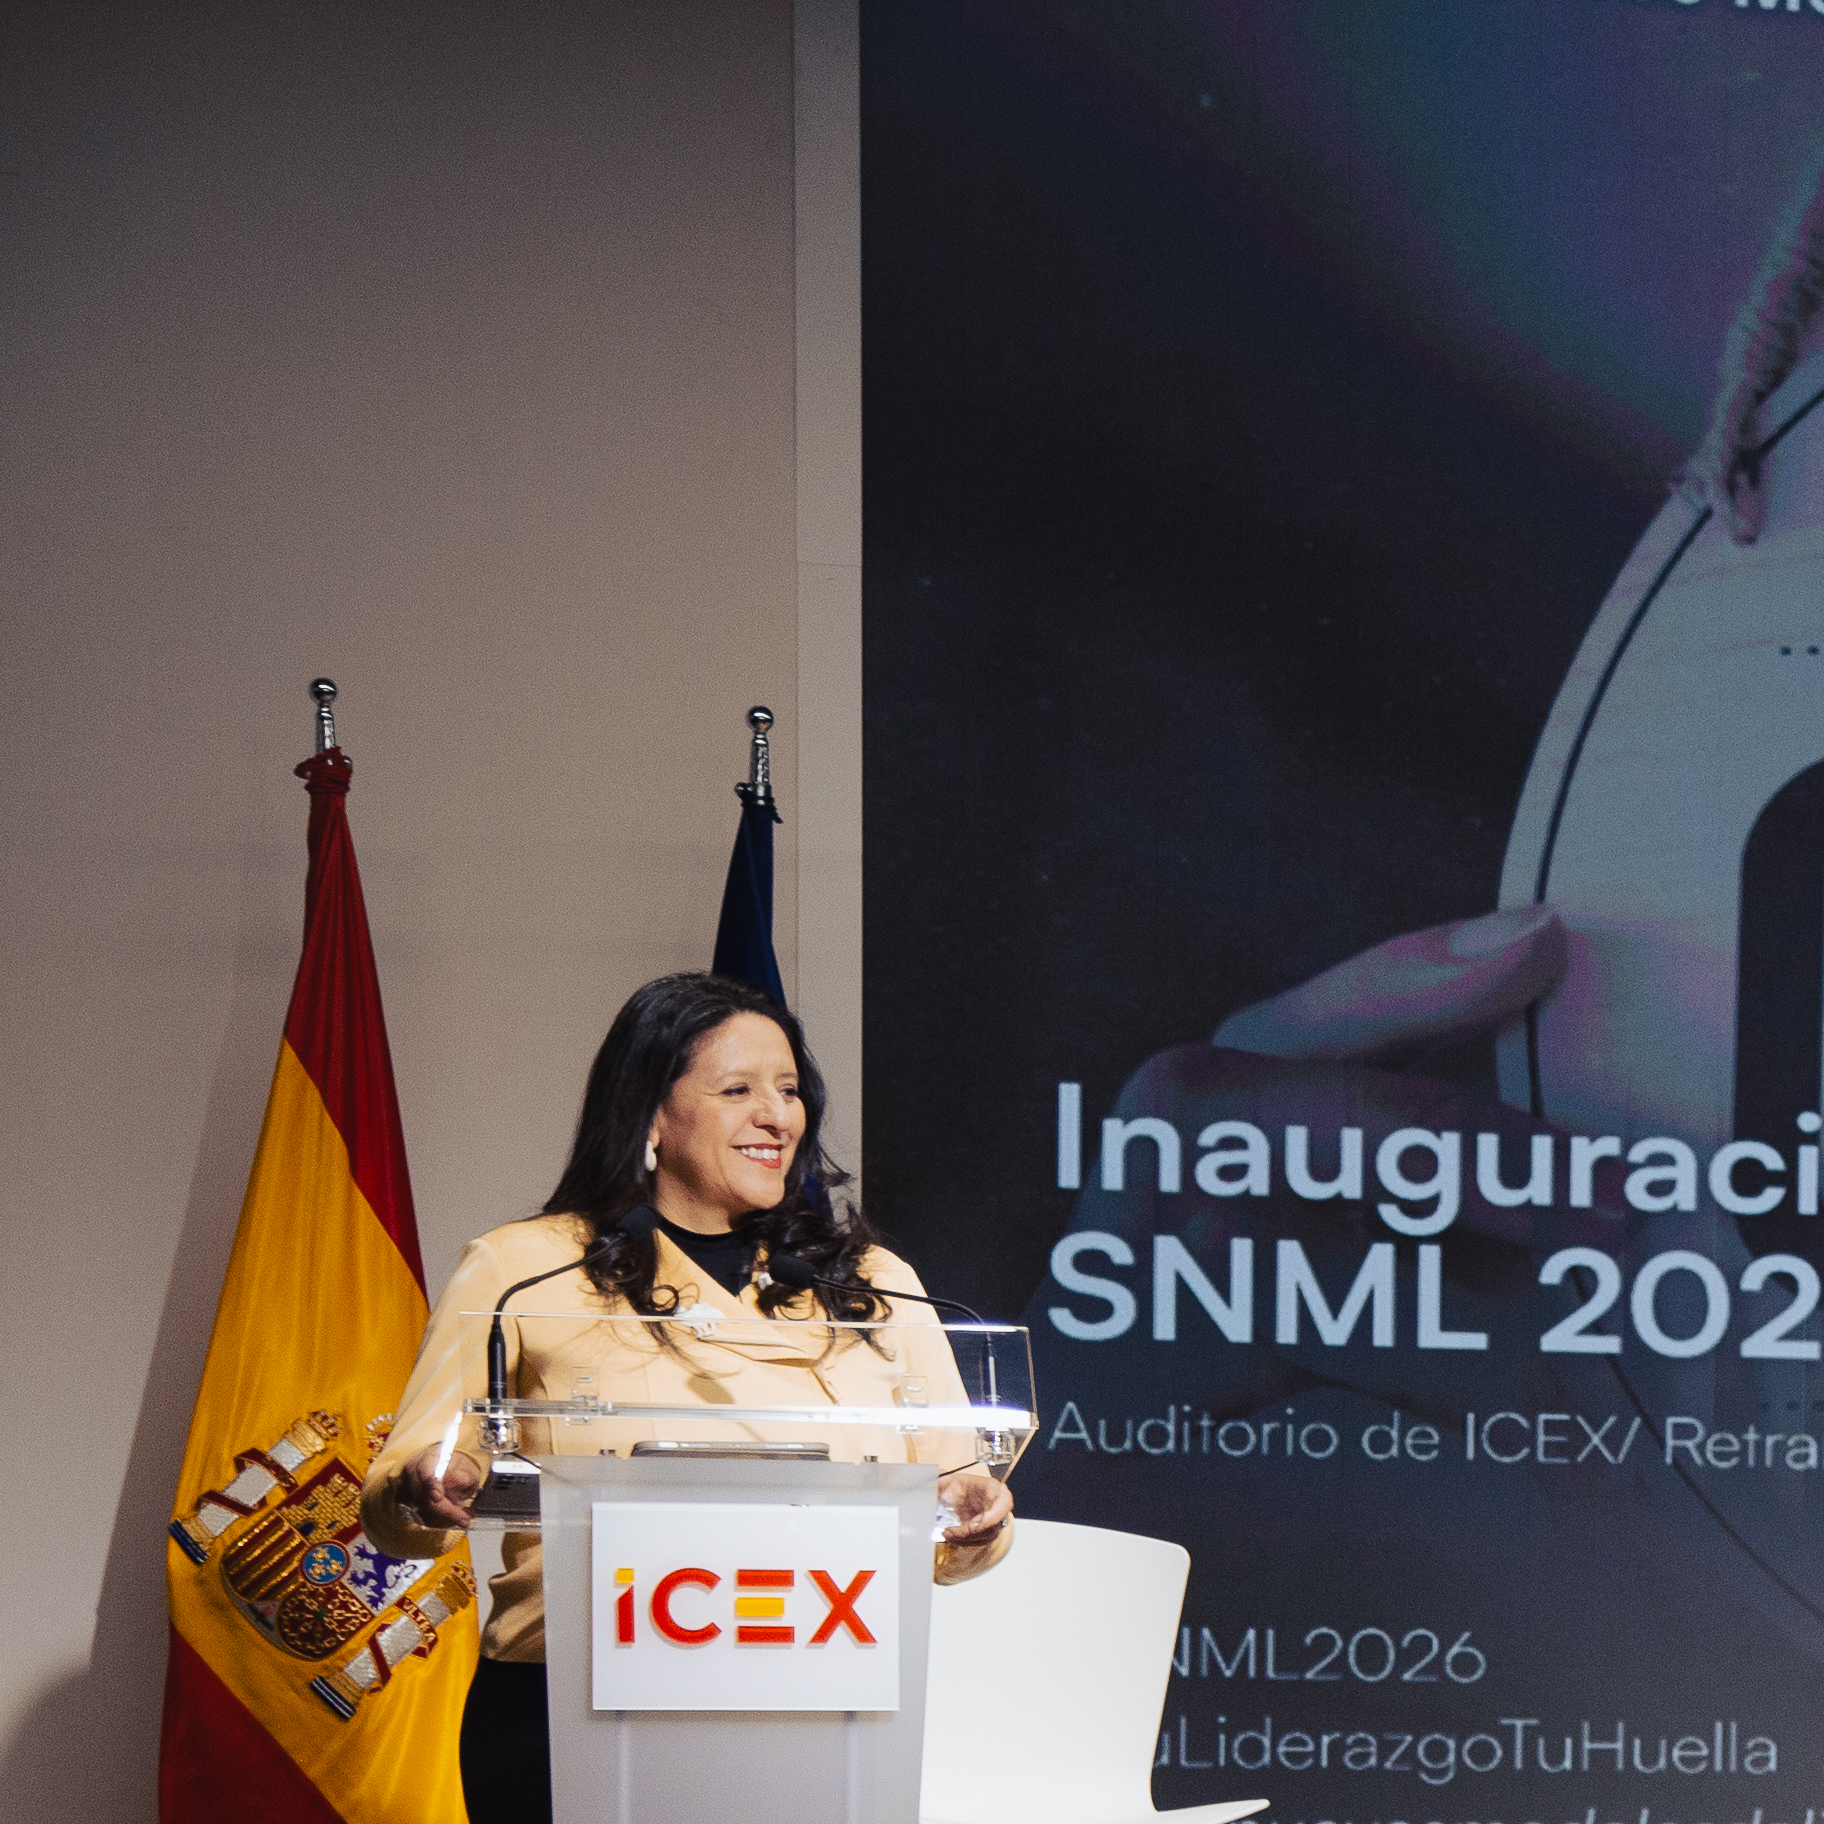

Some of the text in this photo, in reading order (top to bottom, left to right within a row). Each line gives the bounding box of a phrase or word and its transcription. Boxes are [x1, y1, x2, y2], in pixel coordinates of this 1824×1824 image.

[1048, 1231, 1489, 1351] SNML
[1048, 1401, 1340, 1460] Auditorio
[1361, 1411, 1440, 1462] de
[1466, 1413, 1640, 1465] ICEX/
